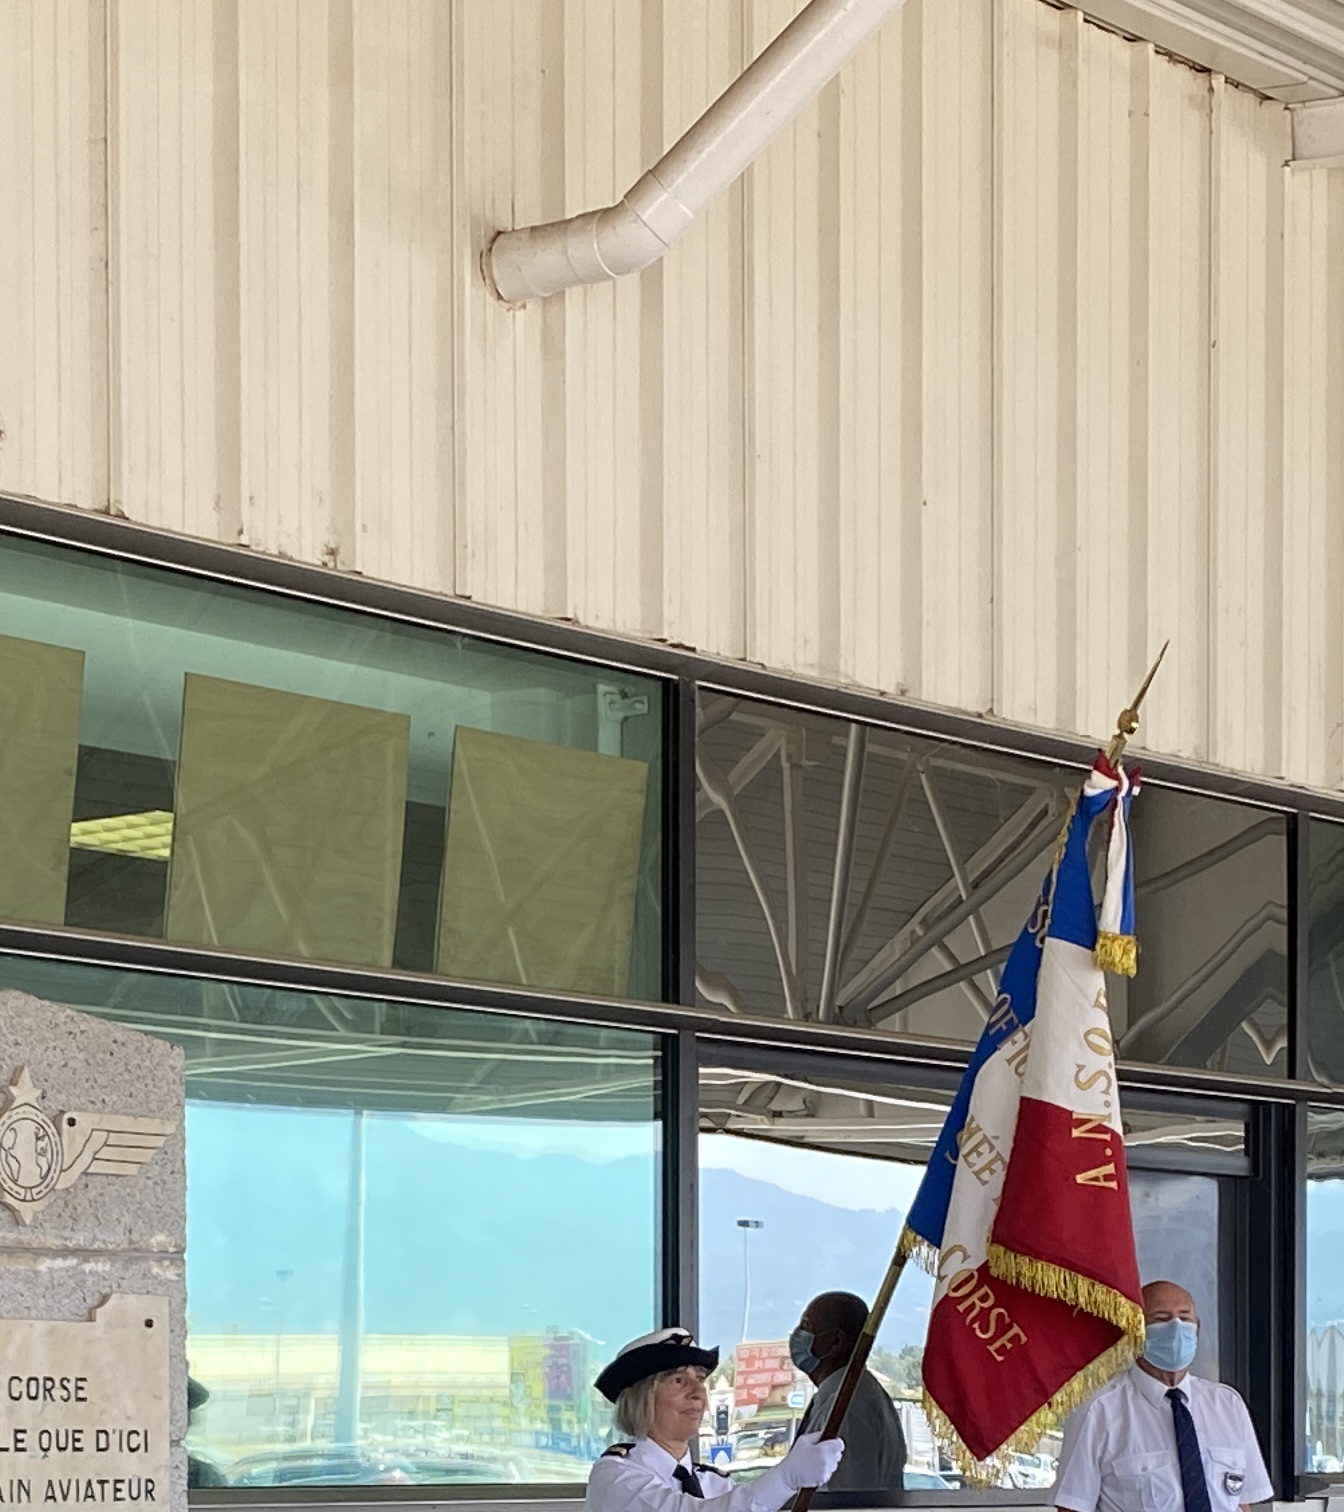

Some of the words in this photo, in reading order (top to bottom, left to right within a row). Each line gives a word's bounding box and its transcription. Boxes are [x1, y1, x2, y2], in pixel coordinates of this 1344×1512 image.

[937, 1244, 1028, 1363] CORSE
[7, 1375, 89, 1402] CORSE
[37, 1428, 85, 1459] QUE
[94, 1428, 150, 1454] D'ICI
[43, 1476, 157, 1502] AVIATEUR
